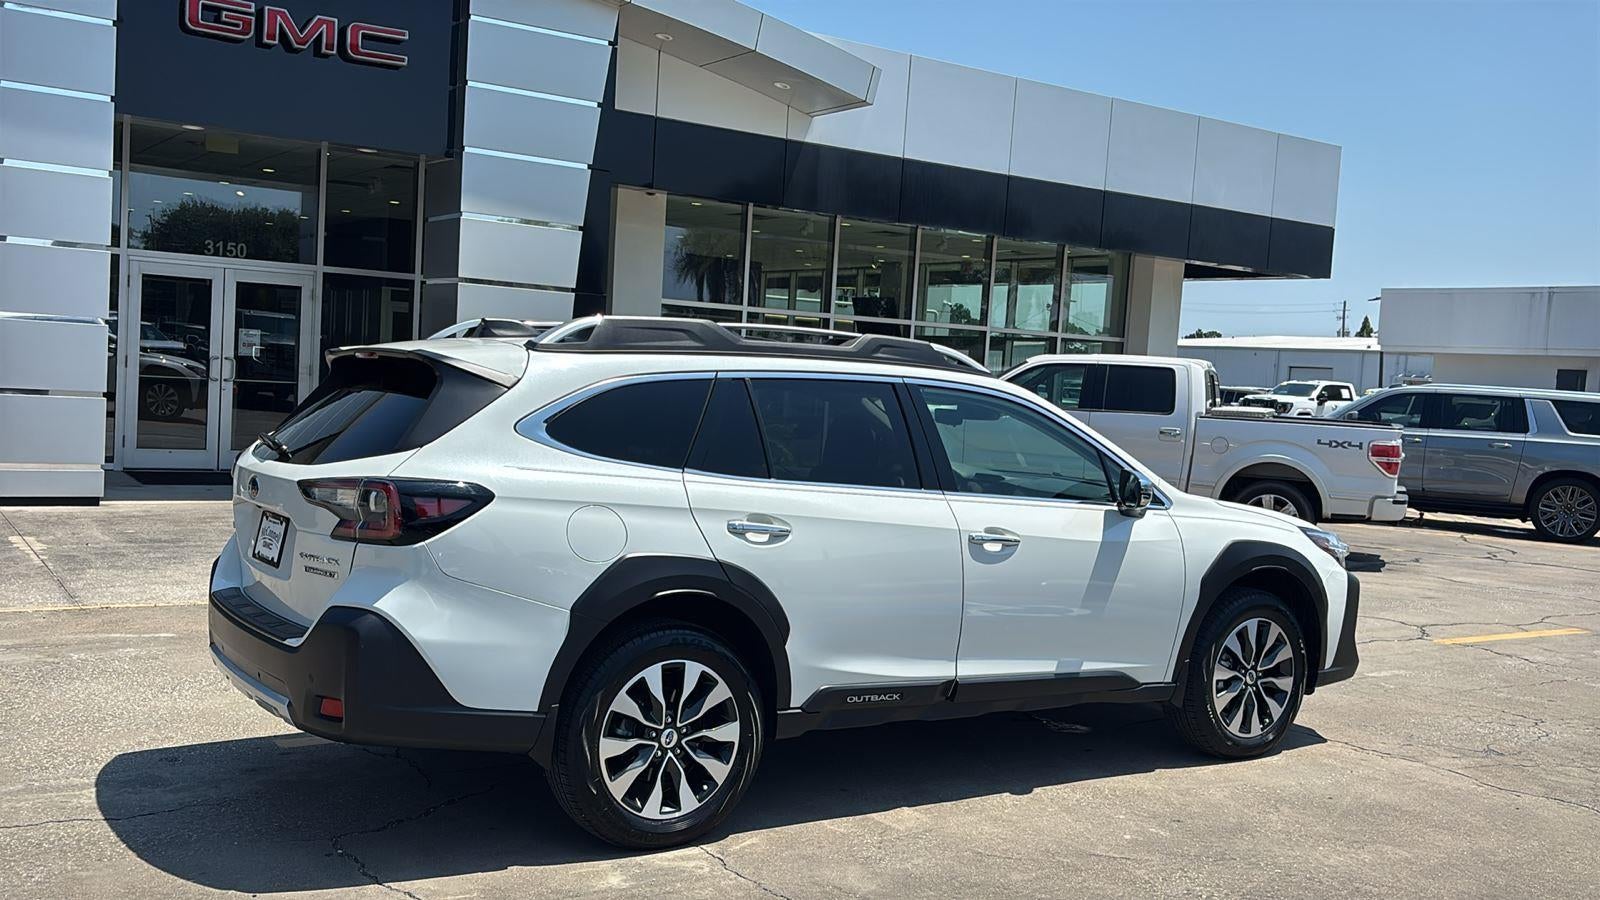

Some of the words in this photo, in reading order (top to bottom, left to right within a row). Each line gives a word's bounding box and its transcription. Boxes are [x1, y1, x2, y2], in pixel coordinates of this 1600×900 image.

[184, 0, 409, 67] GMC
[204, 239, 247, 258] 3150
[846, 693, 901, 703] OUTBACK
